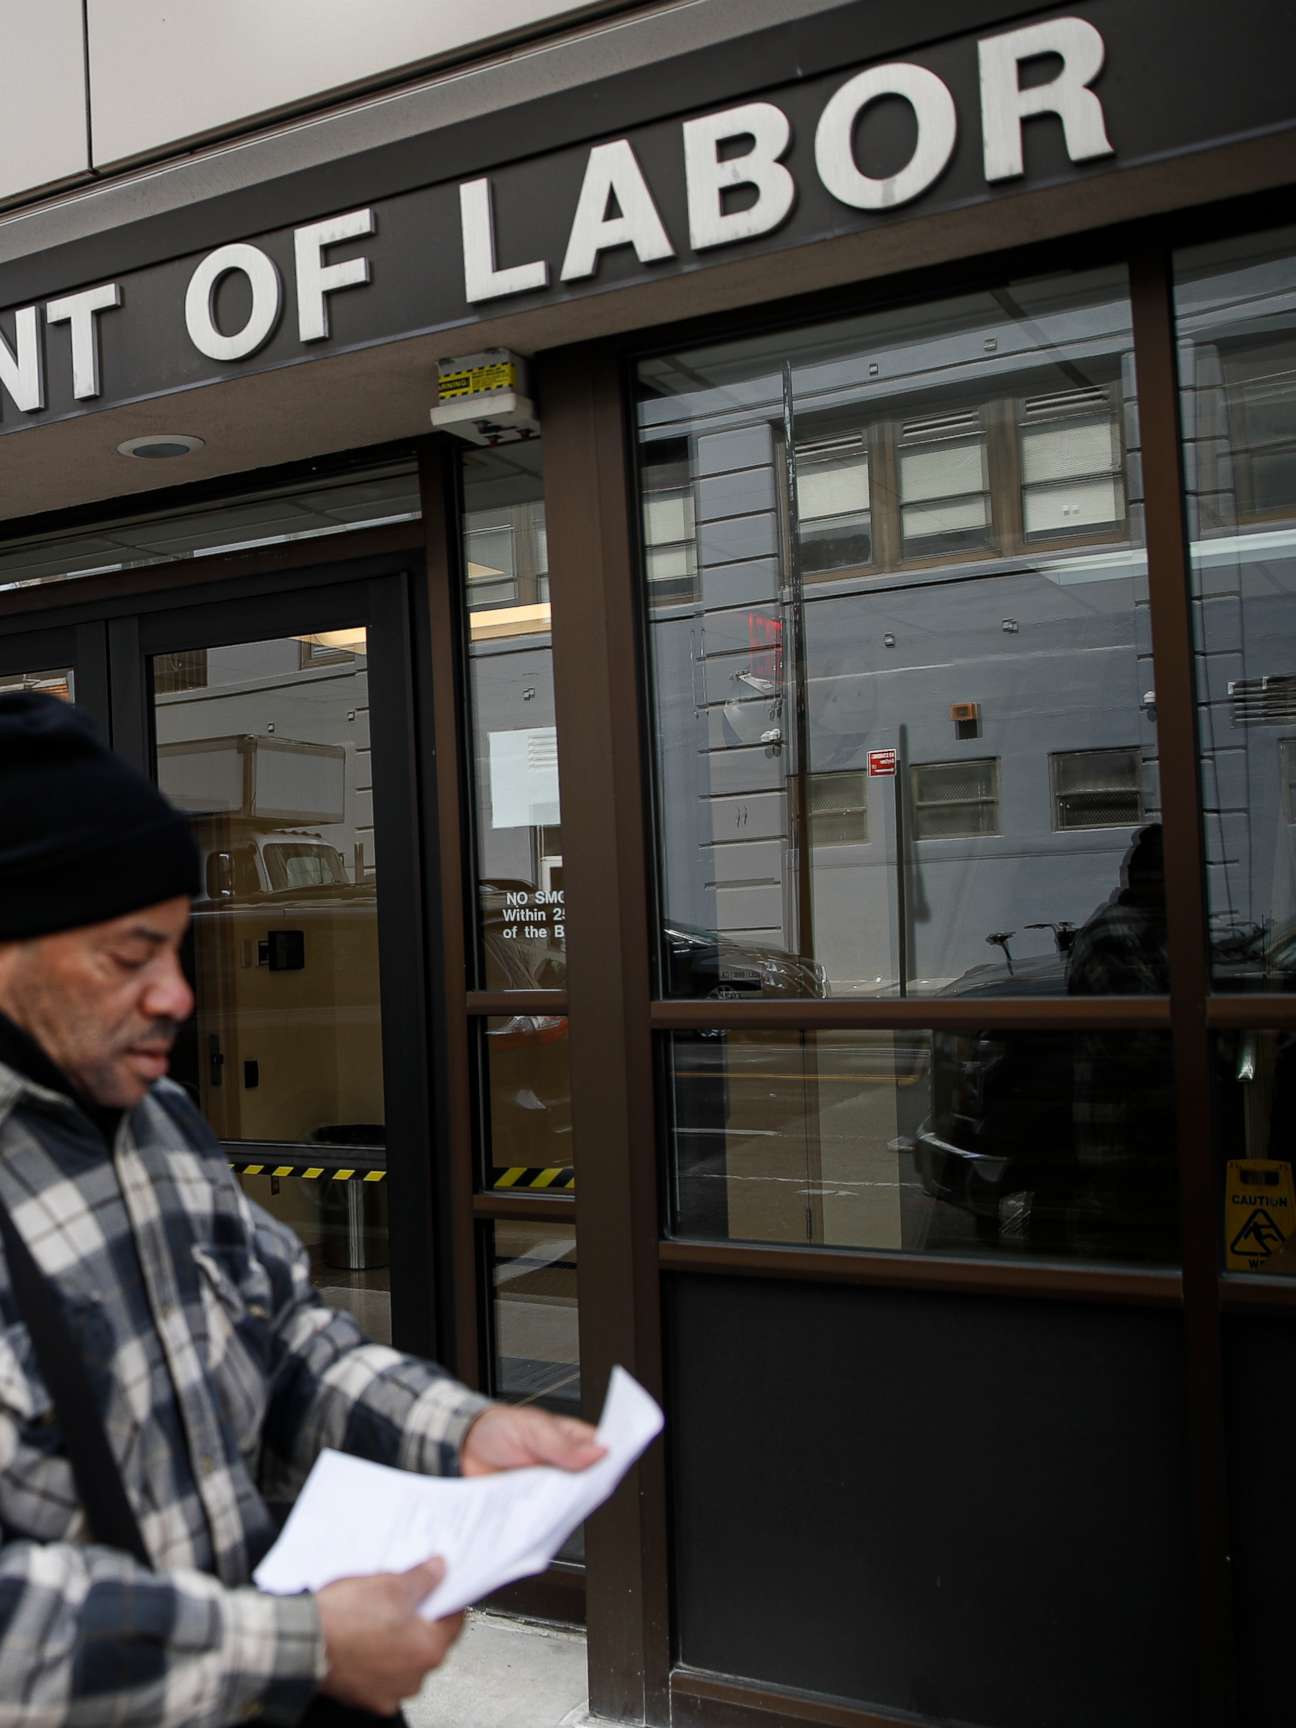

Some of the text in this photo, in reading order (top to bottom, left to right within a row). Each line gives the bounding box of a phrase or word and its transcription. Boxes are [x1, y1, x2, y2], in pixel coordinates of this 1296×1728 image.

[184, 207, 377, 361] OF
[459, 17, 1114, 304] LABOR
[506, 892, 528, 906] NO
[502, 908, 546, 922] Within
[503, 926, 518, 938] of
[525, 925, 547, 938] the
[1231, 1195, 1288, 1208] CAUTION
